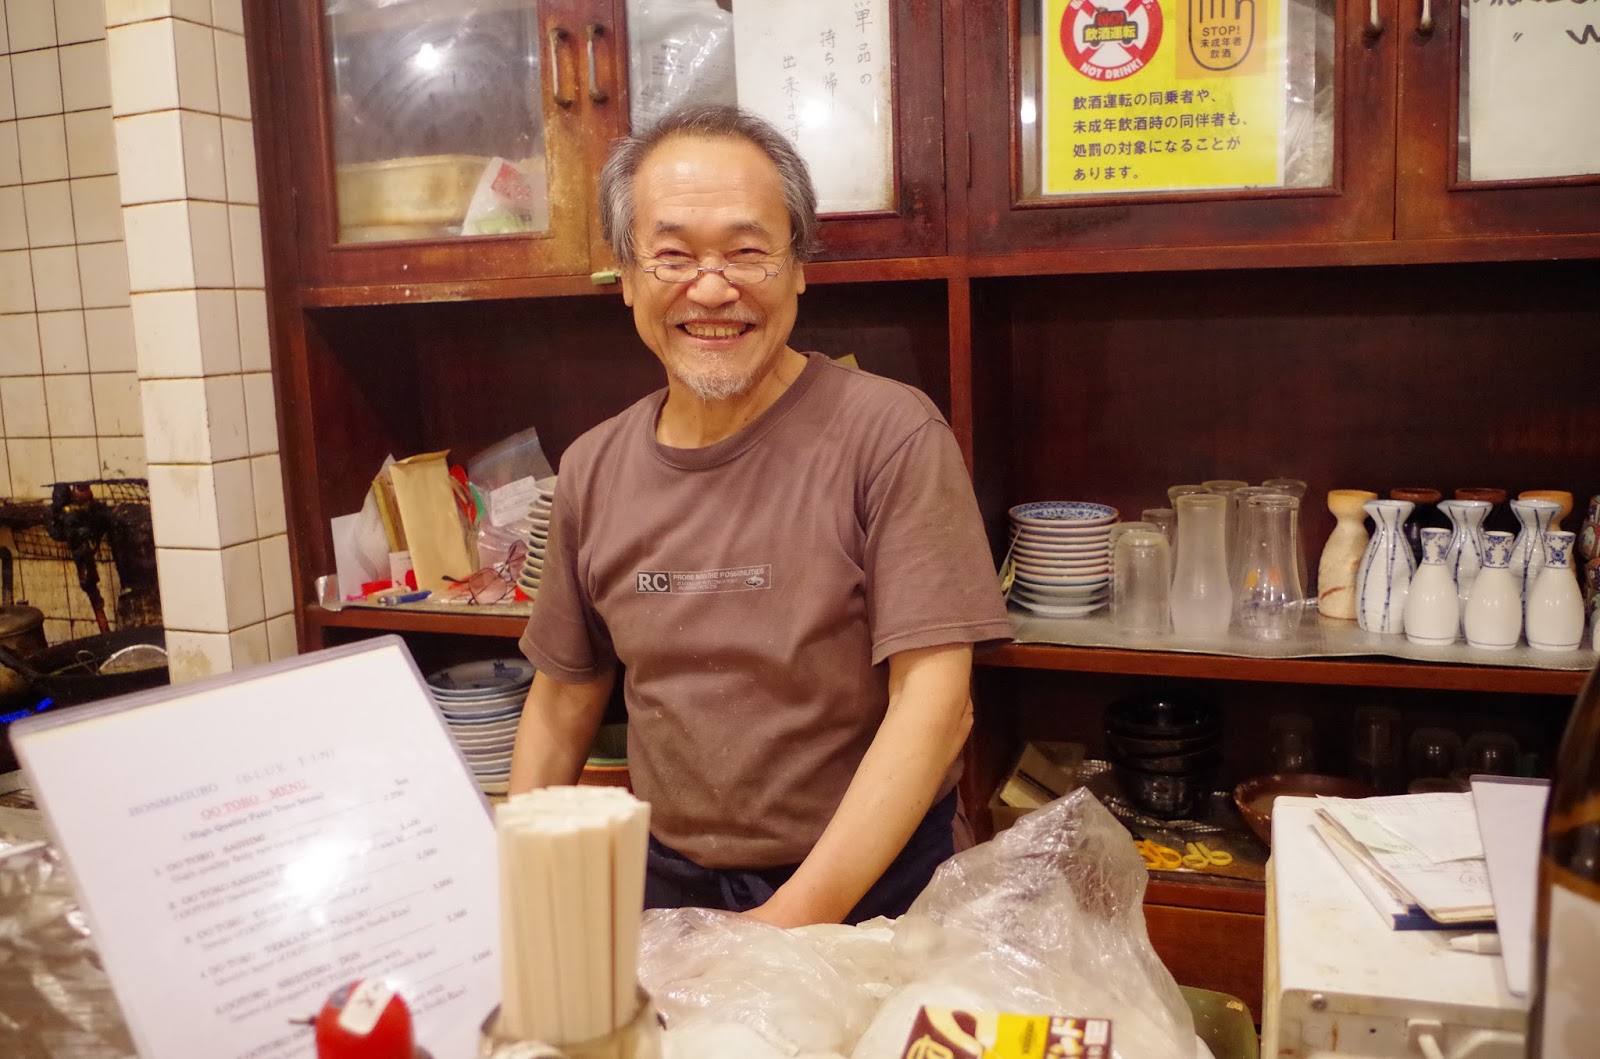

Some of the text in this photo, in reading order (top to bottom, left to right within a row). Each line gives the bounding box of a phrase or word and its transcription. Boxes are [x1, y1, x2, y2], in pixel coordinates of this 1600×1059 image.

[1085, 25, 1136, 41] 飲酒運転
[1203, 25, 1241, 36] STOP!
[1200, 37, 1242, 48] 未成年者
[1210, 48, 1231, 59] 飲酒
[1080, 58, 1143, 79] NOT DRINK!
[1073, 89, 1216, 110] 飲酒運転の同乗者や、
[1073, 112, 1248, 134] 未成年飲酒時の同伴者も、
[1073, 136, 1241, 158] 処罰の対象になることが
[1073, 166, 1140, 181] あります。
[637, 573, 669, 592] RC
